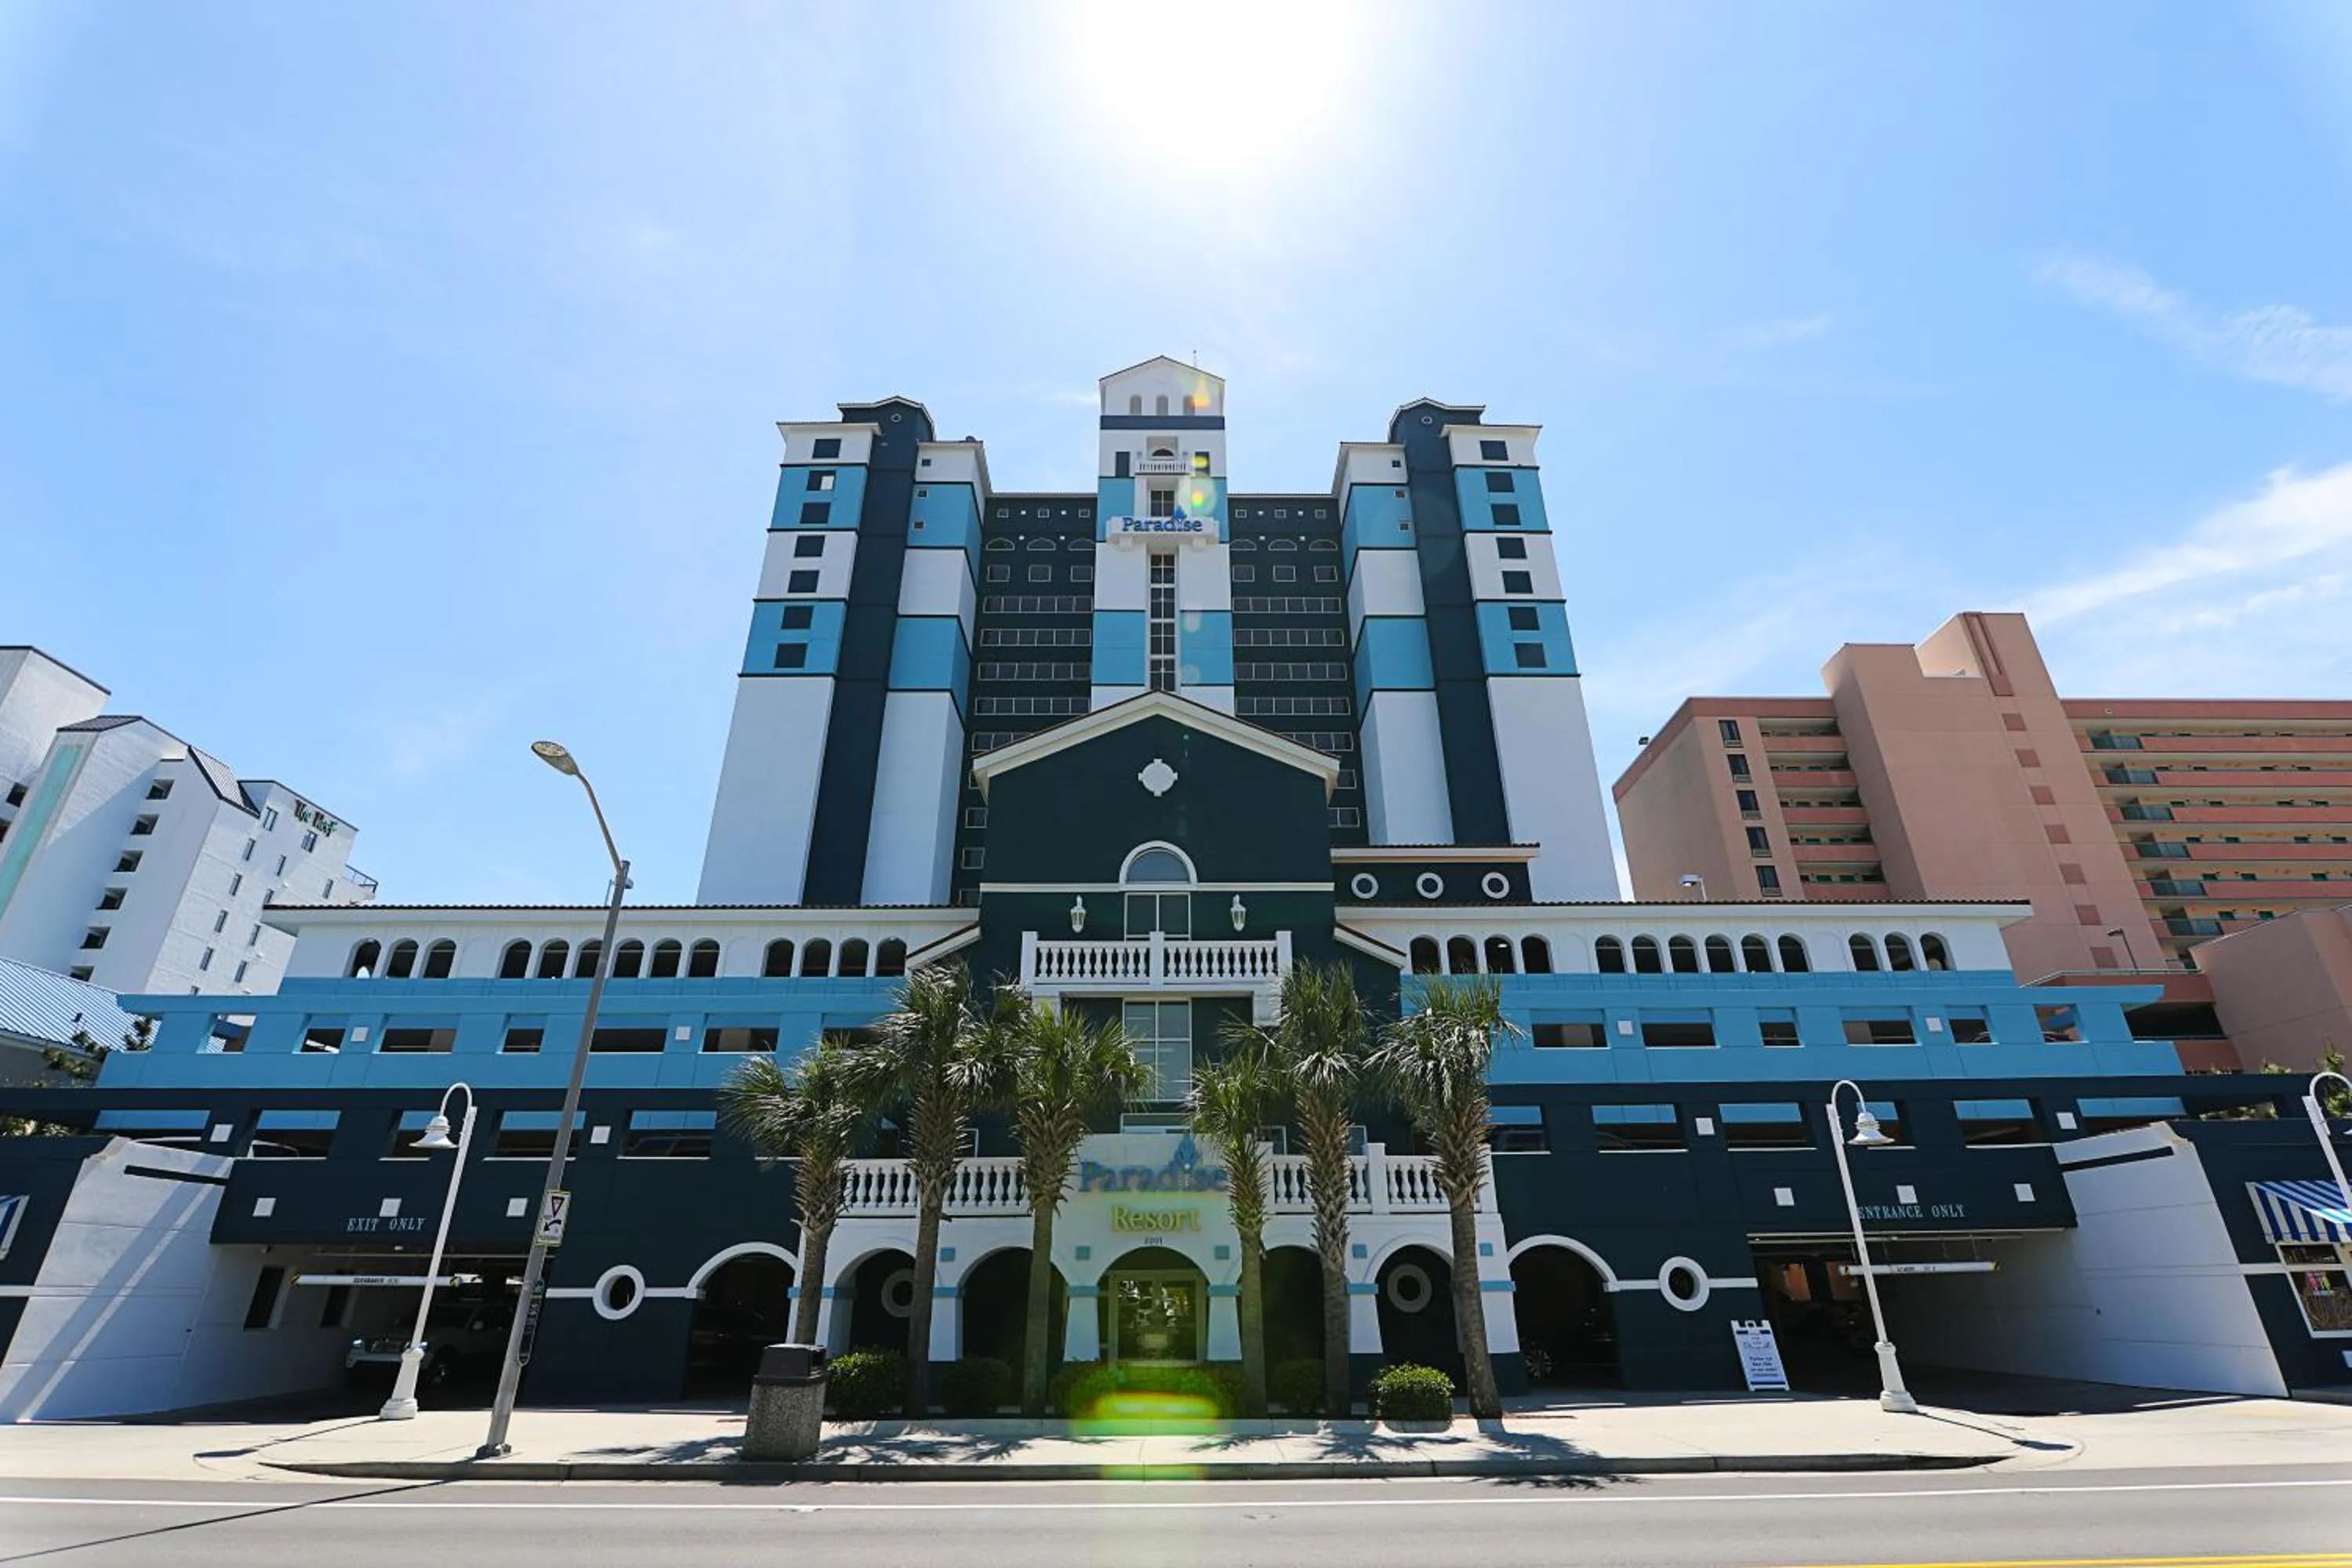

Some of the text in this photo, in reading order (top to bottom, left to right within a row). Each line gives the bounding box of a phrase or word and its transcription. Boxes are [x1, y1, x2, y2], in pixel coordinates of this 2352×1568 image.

[1122, 516, 1203, 532] Paradise
[1079, 1160, 1230, 1192] Paradise
[1112, 1204, 1201, 1232] Resort
[1857, 1203, 1965, 1219] ENTRANCE ONLY
[347, 1217, 426, 1232] EXIT ONLY
